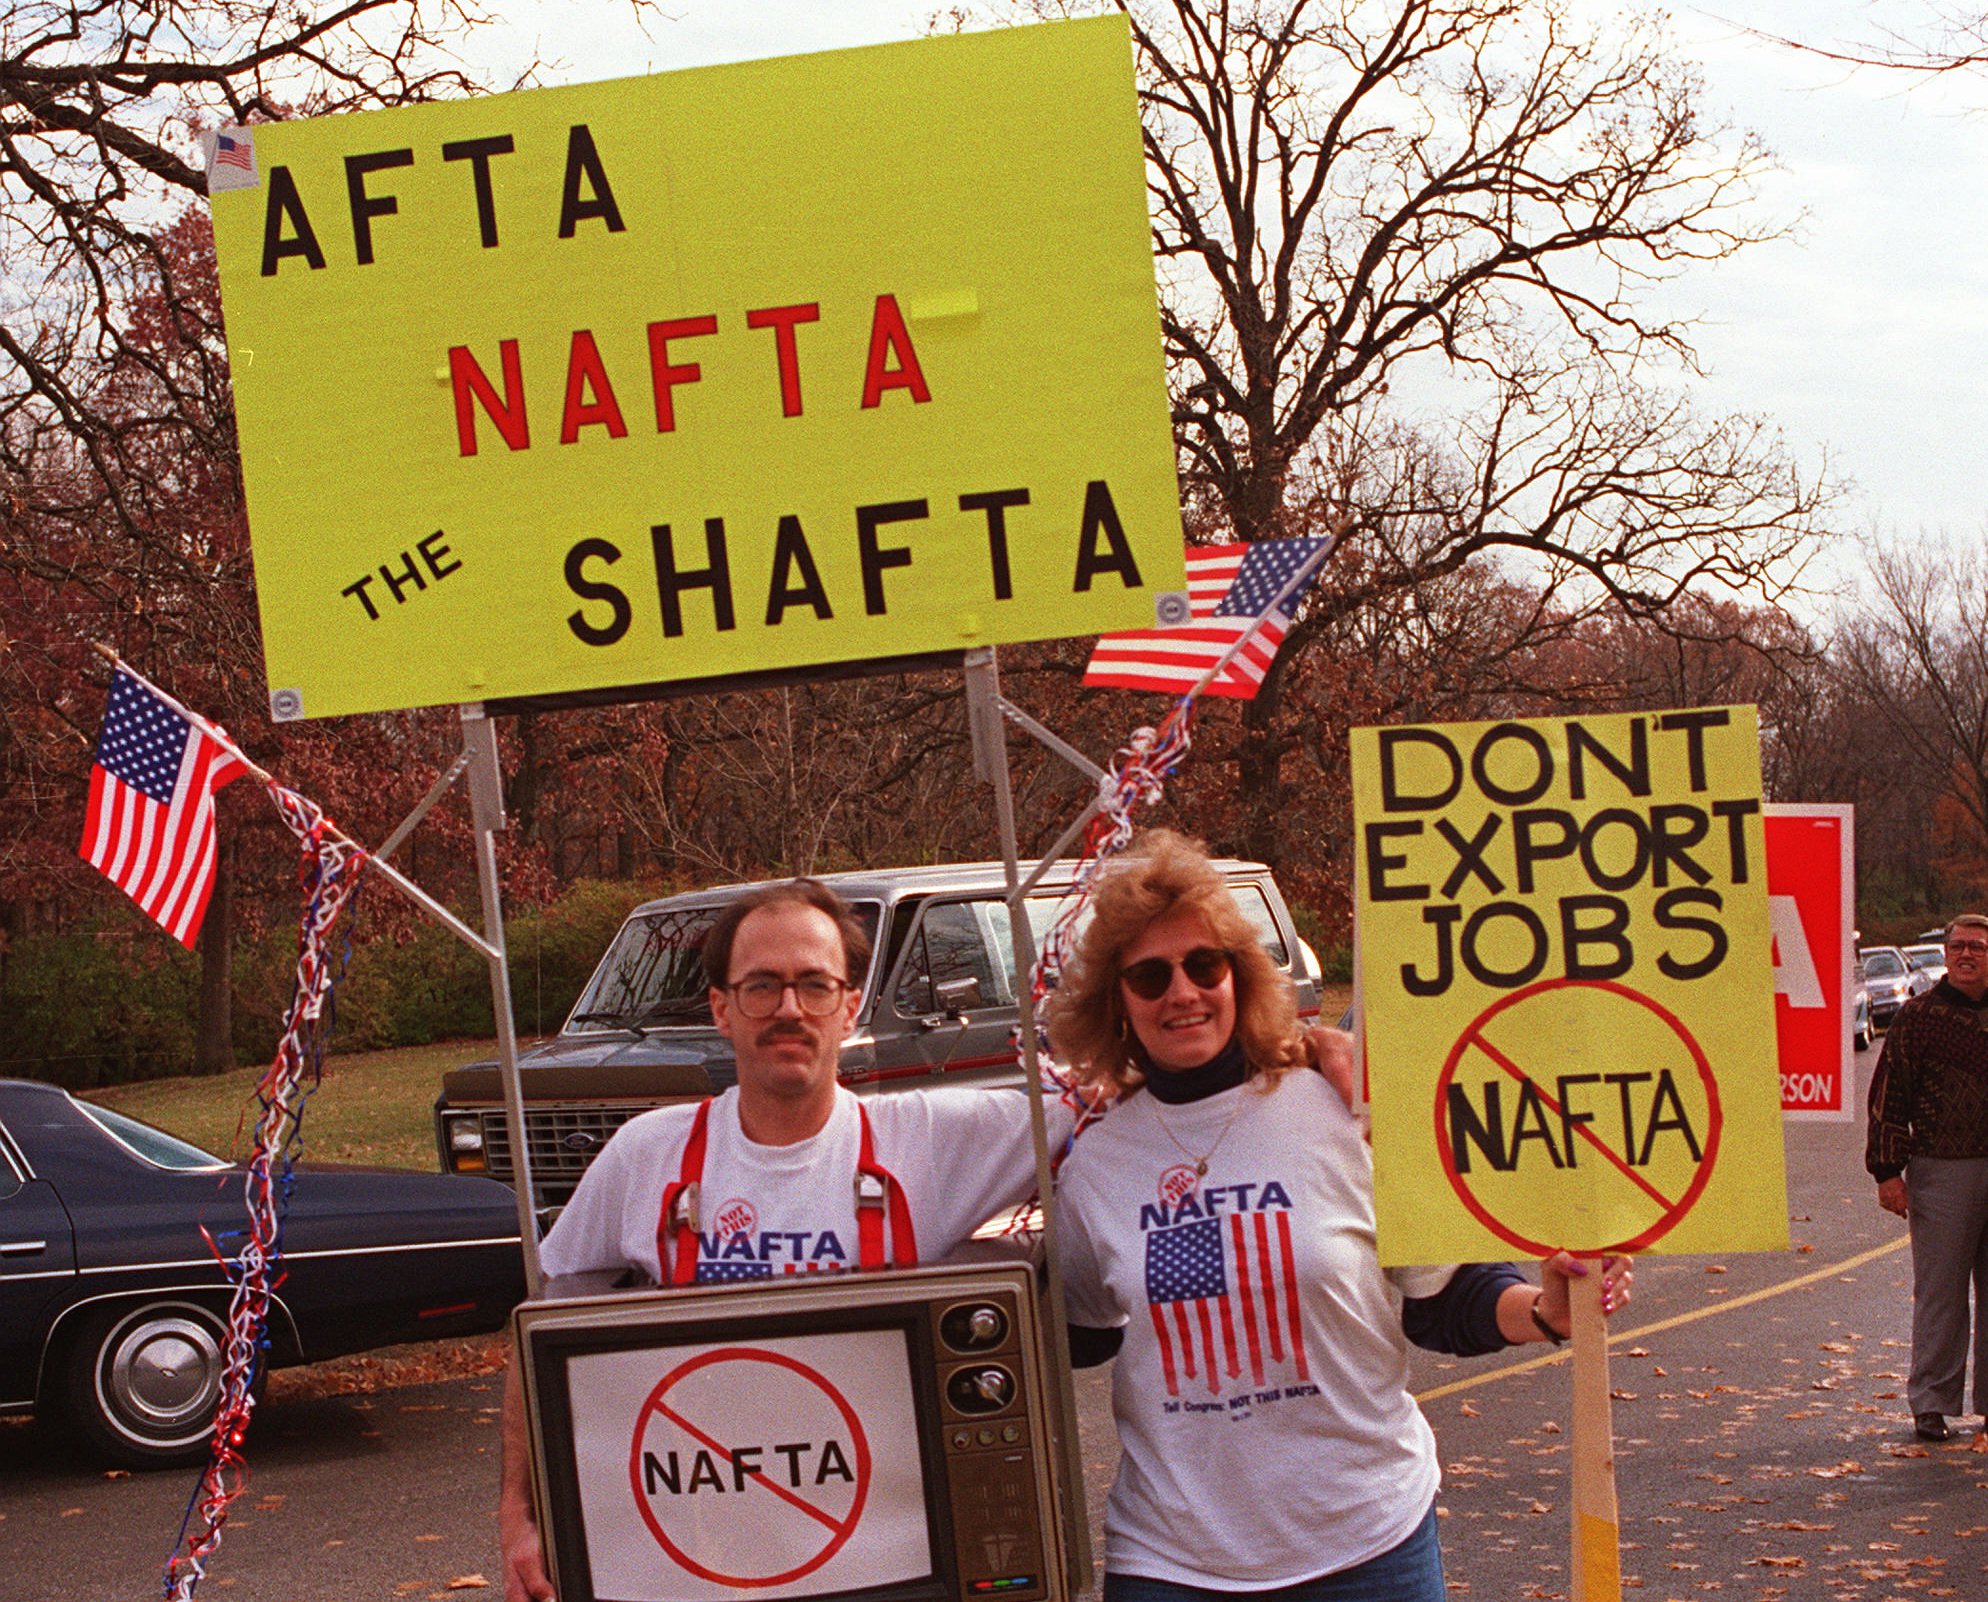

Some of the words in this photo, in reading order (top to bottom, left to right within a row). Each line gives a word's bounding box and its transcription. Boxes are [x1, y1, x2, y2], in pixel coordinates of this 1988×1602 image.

[261, 123, 627, 278] AFTA
[448, 294, 932, 457] NAFTA
[341, 529, 463, 621] THE
[563, 479, 1144, 647] SHAFTA
[1377, 708, 1730, 813] DON'T
[1364, 797, 1760, 902] EXPORT
[1401, 886, 1729, 997] JOBS
[1447, 1068, 1703, 1175] NAFTA
[720, 1205, 745, 1223] NOT
[722, 1213, 753, 1236] THIS
[1140, 1181, 1293, 1231] NAFTA
[1164, 1171, 1188, 1191] NOT
[1229, 1394, 1251, 1410] NOT
[1255, 1389, 1281, 1404] THIS
[1284, 1384, 1321, 1399] NAFTA
[643, 1440, 856, 1496] NAFTA
